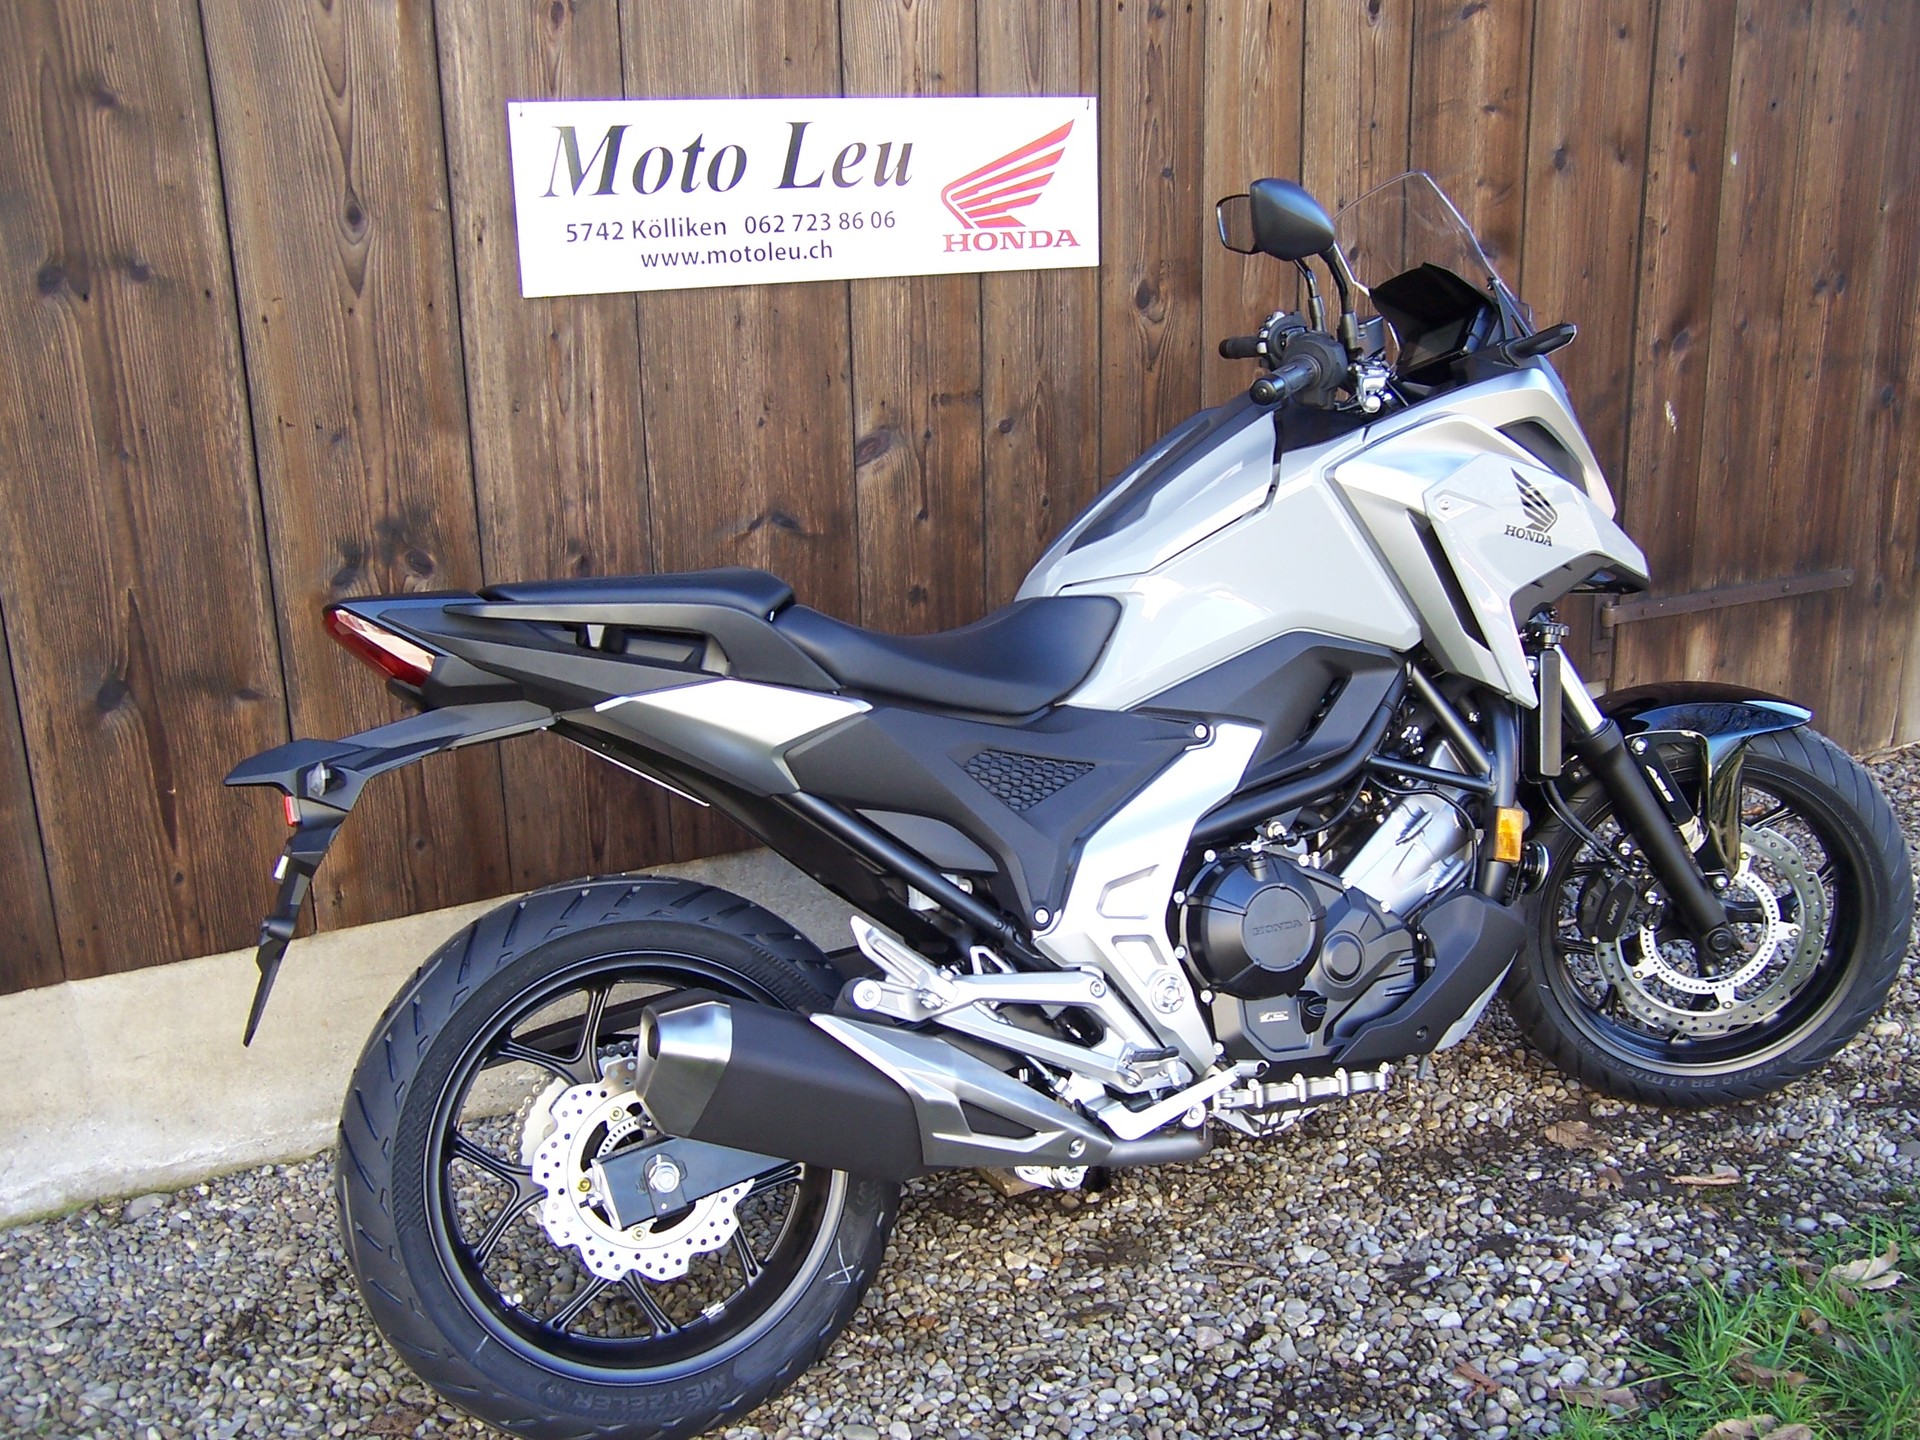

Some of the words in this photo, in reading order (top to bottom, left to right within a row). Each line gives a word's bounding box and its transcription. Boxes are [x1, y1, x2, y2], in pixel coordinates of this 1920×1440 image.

[540, 124, 748, 198] Moto
[775, 121, 913, 190] Leu
[566, 221, 624, 243] 5742
[632, 214, 727, 241] Kölliken
[744, 214, 785, 236] 062
[792, 212, 831, 233] 723
[838, 211, 864, 231] 86
[870, 210, 896, 230] 06
[943, 229, 1081, 253] HONDA
[640, 239, 833, 268] www.motoleu.ch
[1504, 524, 1553, 547] HONDA
[1252, 919, 1304, 937] HONDA
[572, 1374, 727, 1411] METZELER
